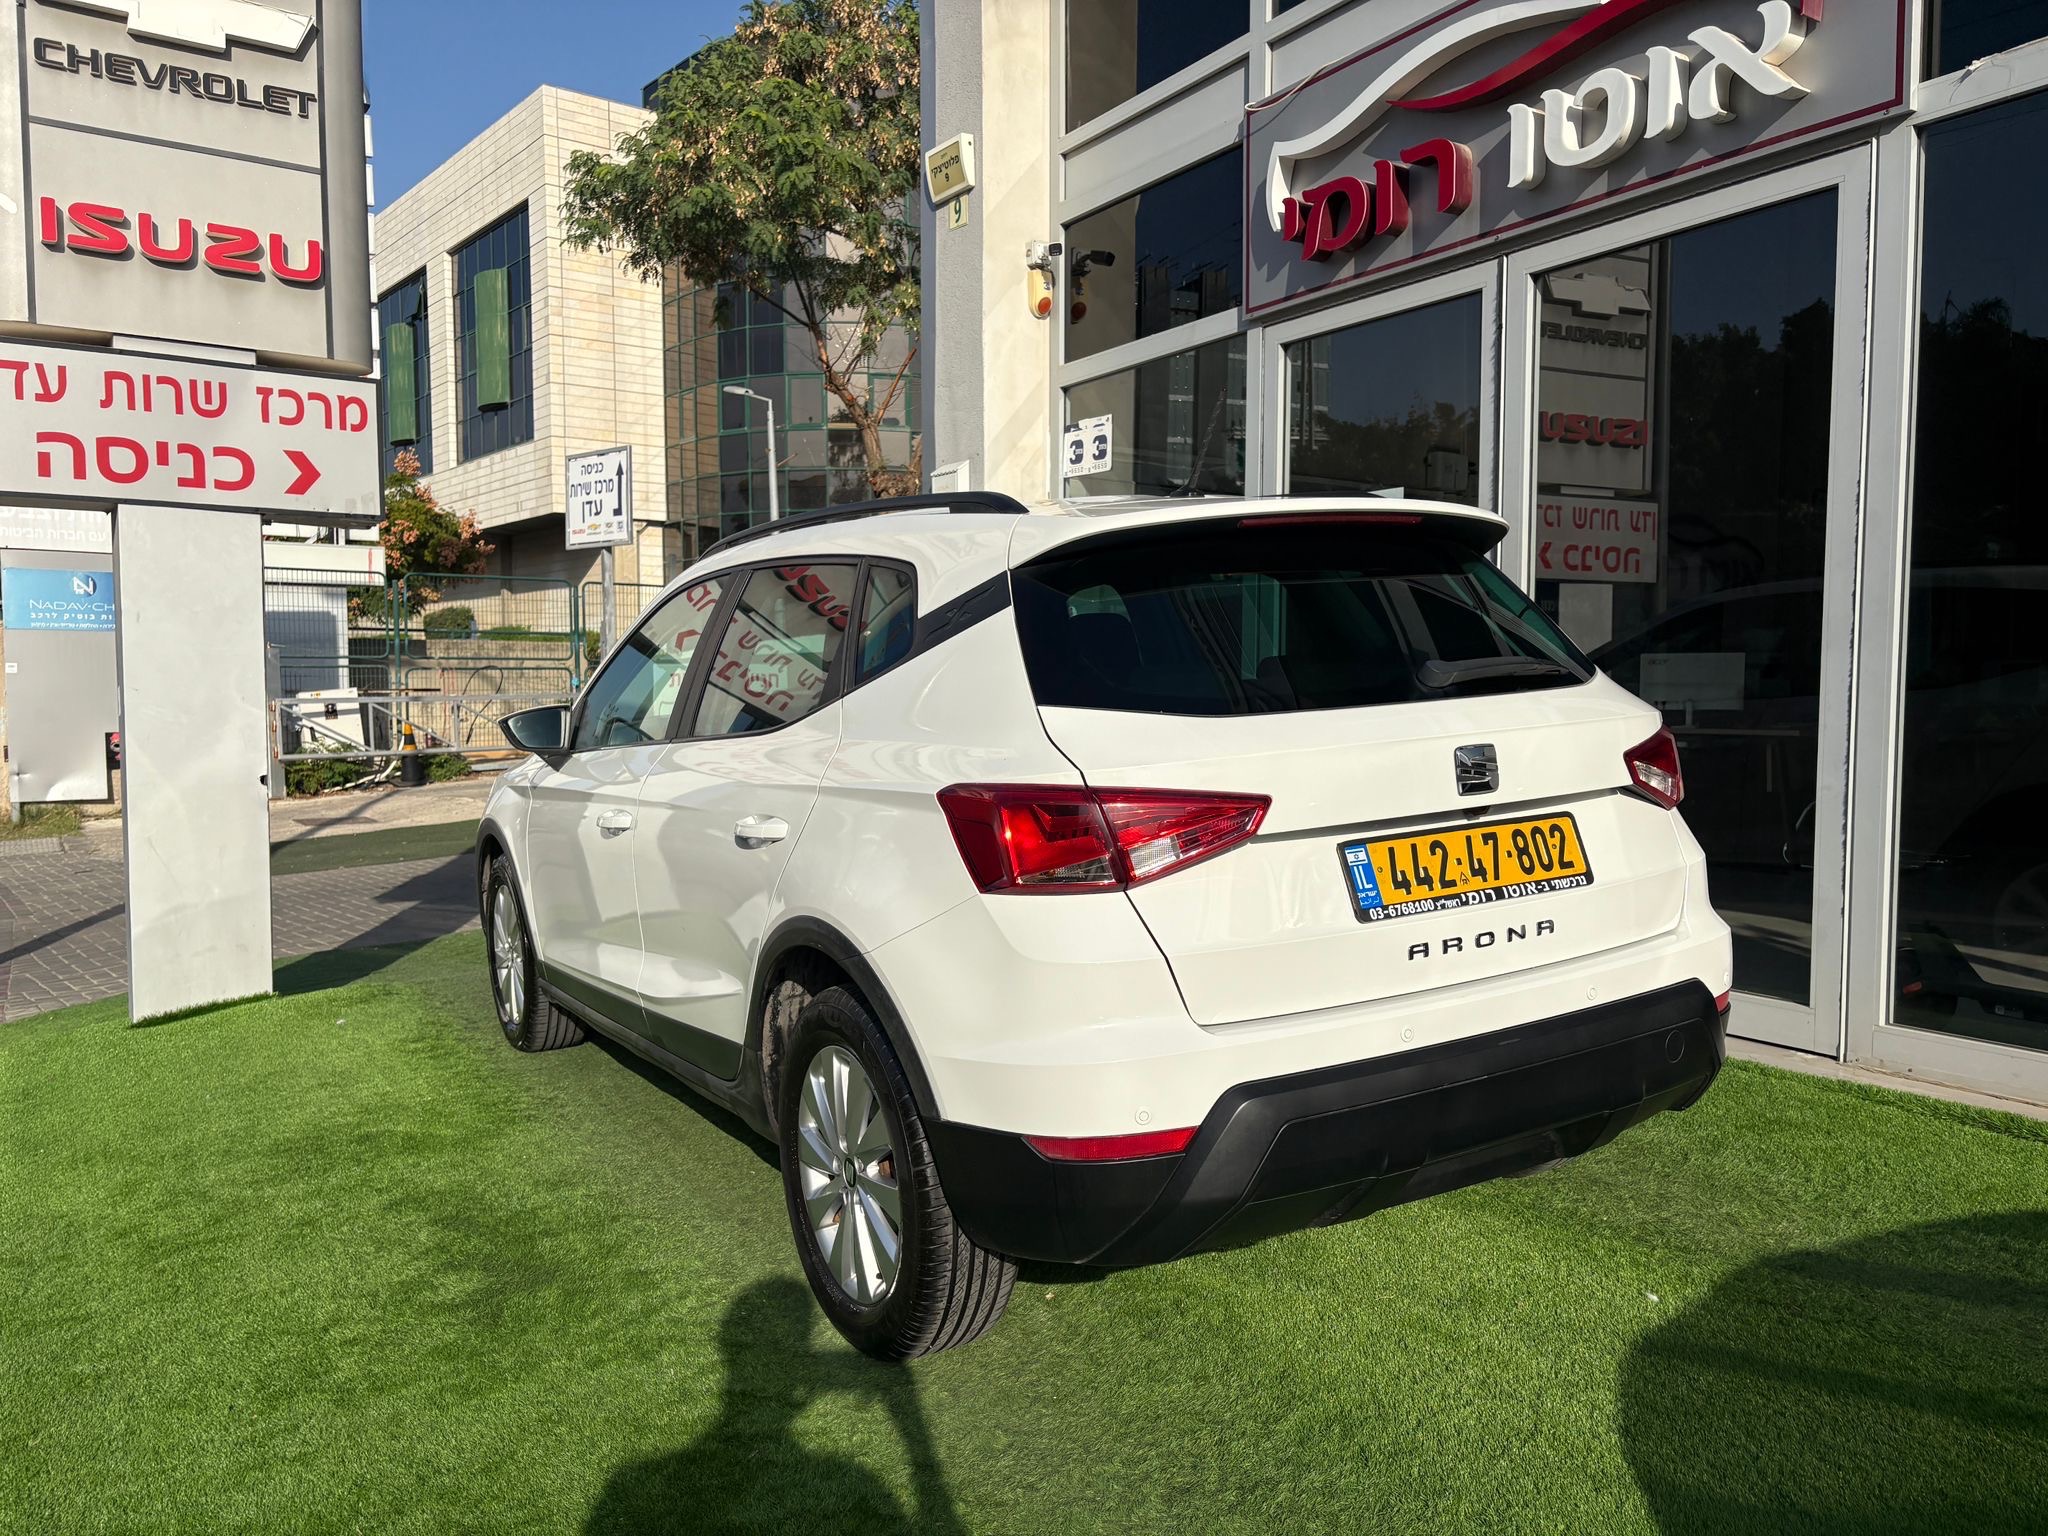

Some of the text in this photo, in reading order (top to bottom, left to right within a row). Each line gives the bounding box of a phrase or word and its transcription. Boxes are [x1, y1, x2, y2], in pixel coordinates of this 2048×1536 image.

[33, 36, 317, 118] CHEVROLET
[1281, 0, 1811, 262] אוטו רומי
[944, 172, 950, 182] 9
[954, 197, 961, 223] 9
[40, 196, 324, 284] ISUZU
[0, 359, 369, 433] מרכז שרות עד
[36, 431, 256, 492] כניסה
[580, 462, 604, 476] כניסה
[570, 478, 614, 498] מרכז שירות
[582, 499, 603, 523] עדן
[1353, 865, 1373, 890] IL
[1551, 875, 1587, 890] נרכשתי
[1461, 888, 1496, 905] רומי
[1369, 899, 1435, 920] 03-6768100
[1407, 919, 1555, 961] ARONA
